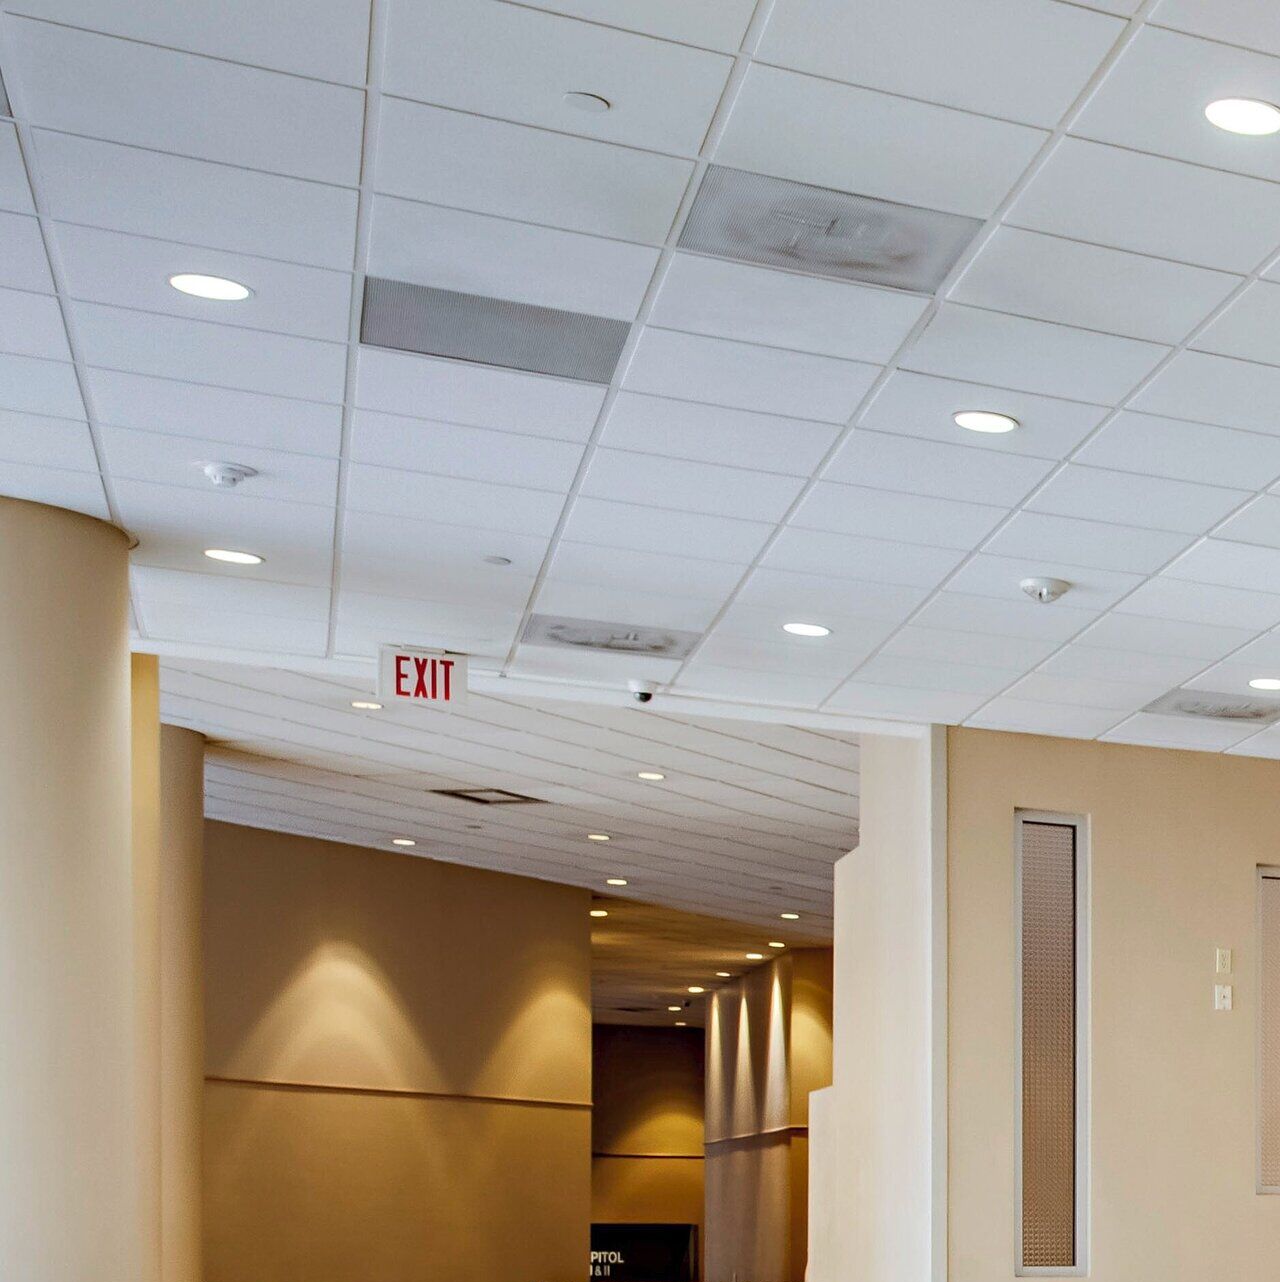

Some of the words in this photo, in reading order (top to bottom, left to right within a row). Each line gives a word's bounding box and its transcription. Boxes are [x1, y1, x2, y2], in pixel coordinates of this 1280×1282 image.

[395, 655, 454, 702] EXIT
[591, 1252, 624, 1263] PITOL
[594, 1265, 602, 1276] &
[604, 1265, 610, 1276] II
